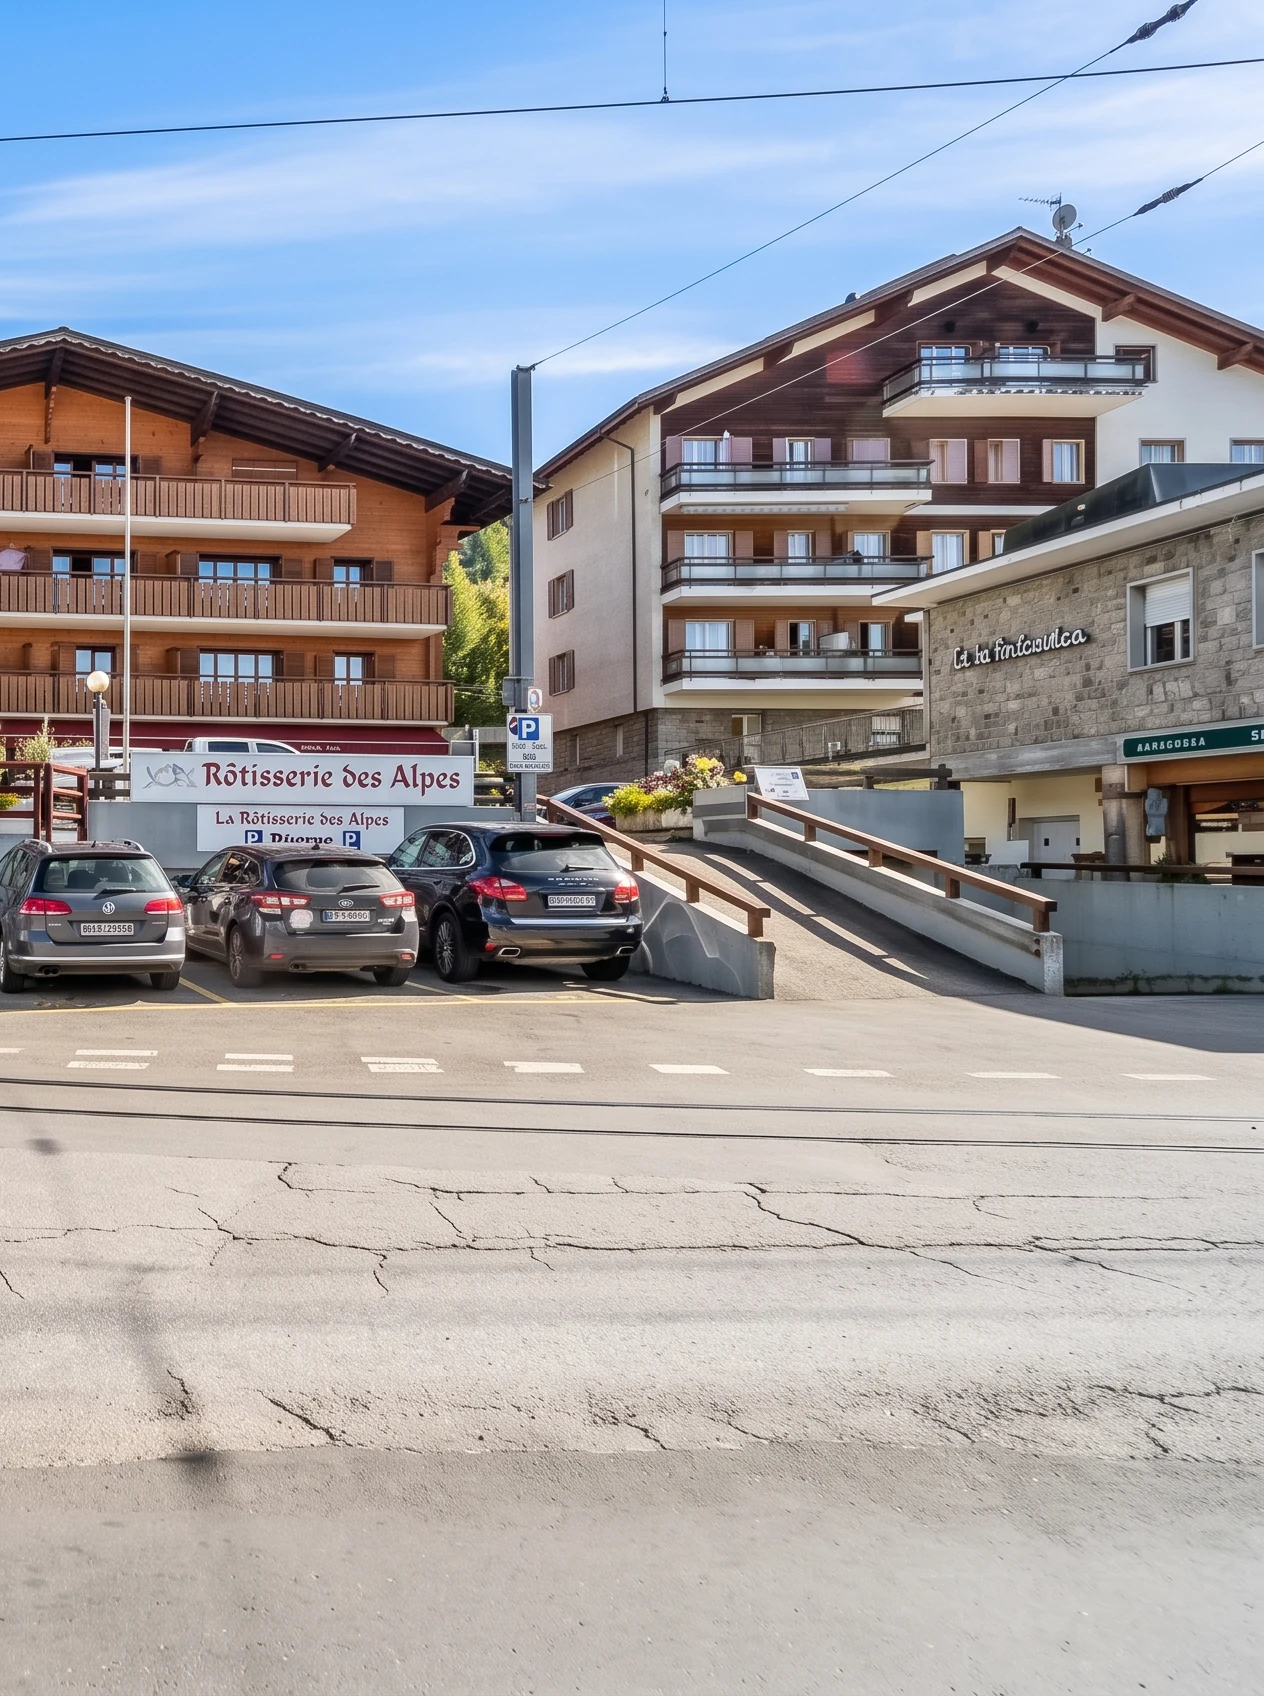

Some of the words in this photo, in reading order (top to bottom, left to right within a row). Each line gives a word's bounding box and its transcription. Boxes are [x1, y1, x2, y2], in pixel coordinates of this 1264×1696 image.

[521, 720, 536, 739] P
[201, 761, 333, 789] Rôtisserie
[342, 763, 382, 789] des
[390, 763, 461, 796] Alpes
[215, 811, 235, 825] La
[239, 811, 315, 825] Rôtisserie
[320, 812, 343, 826] des
[348, 812, 389, 830] Alpes
